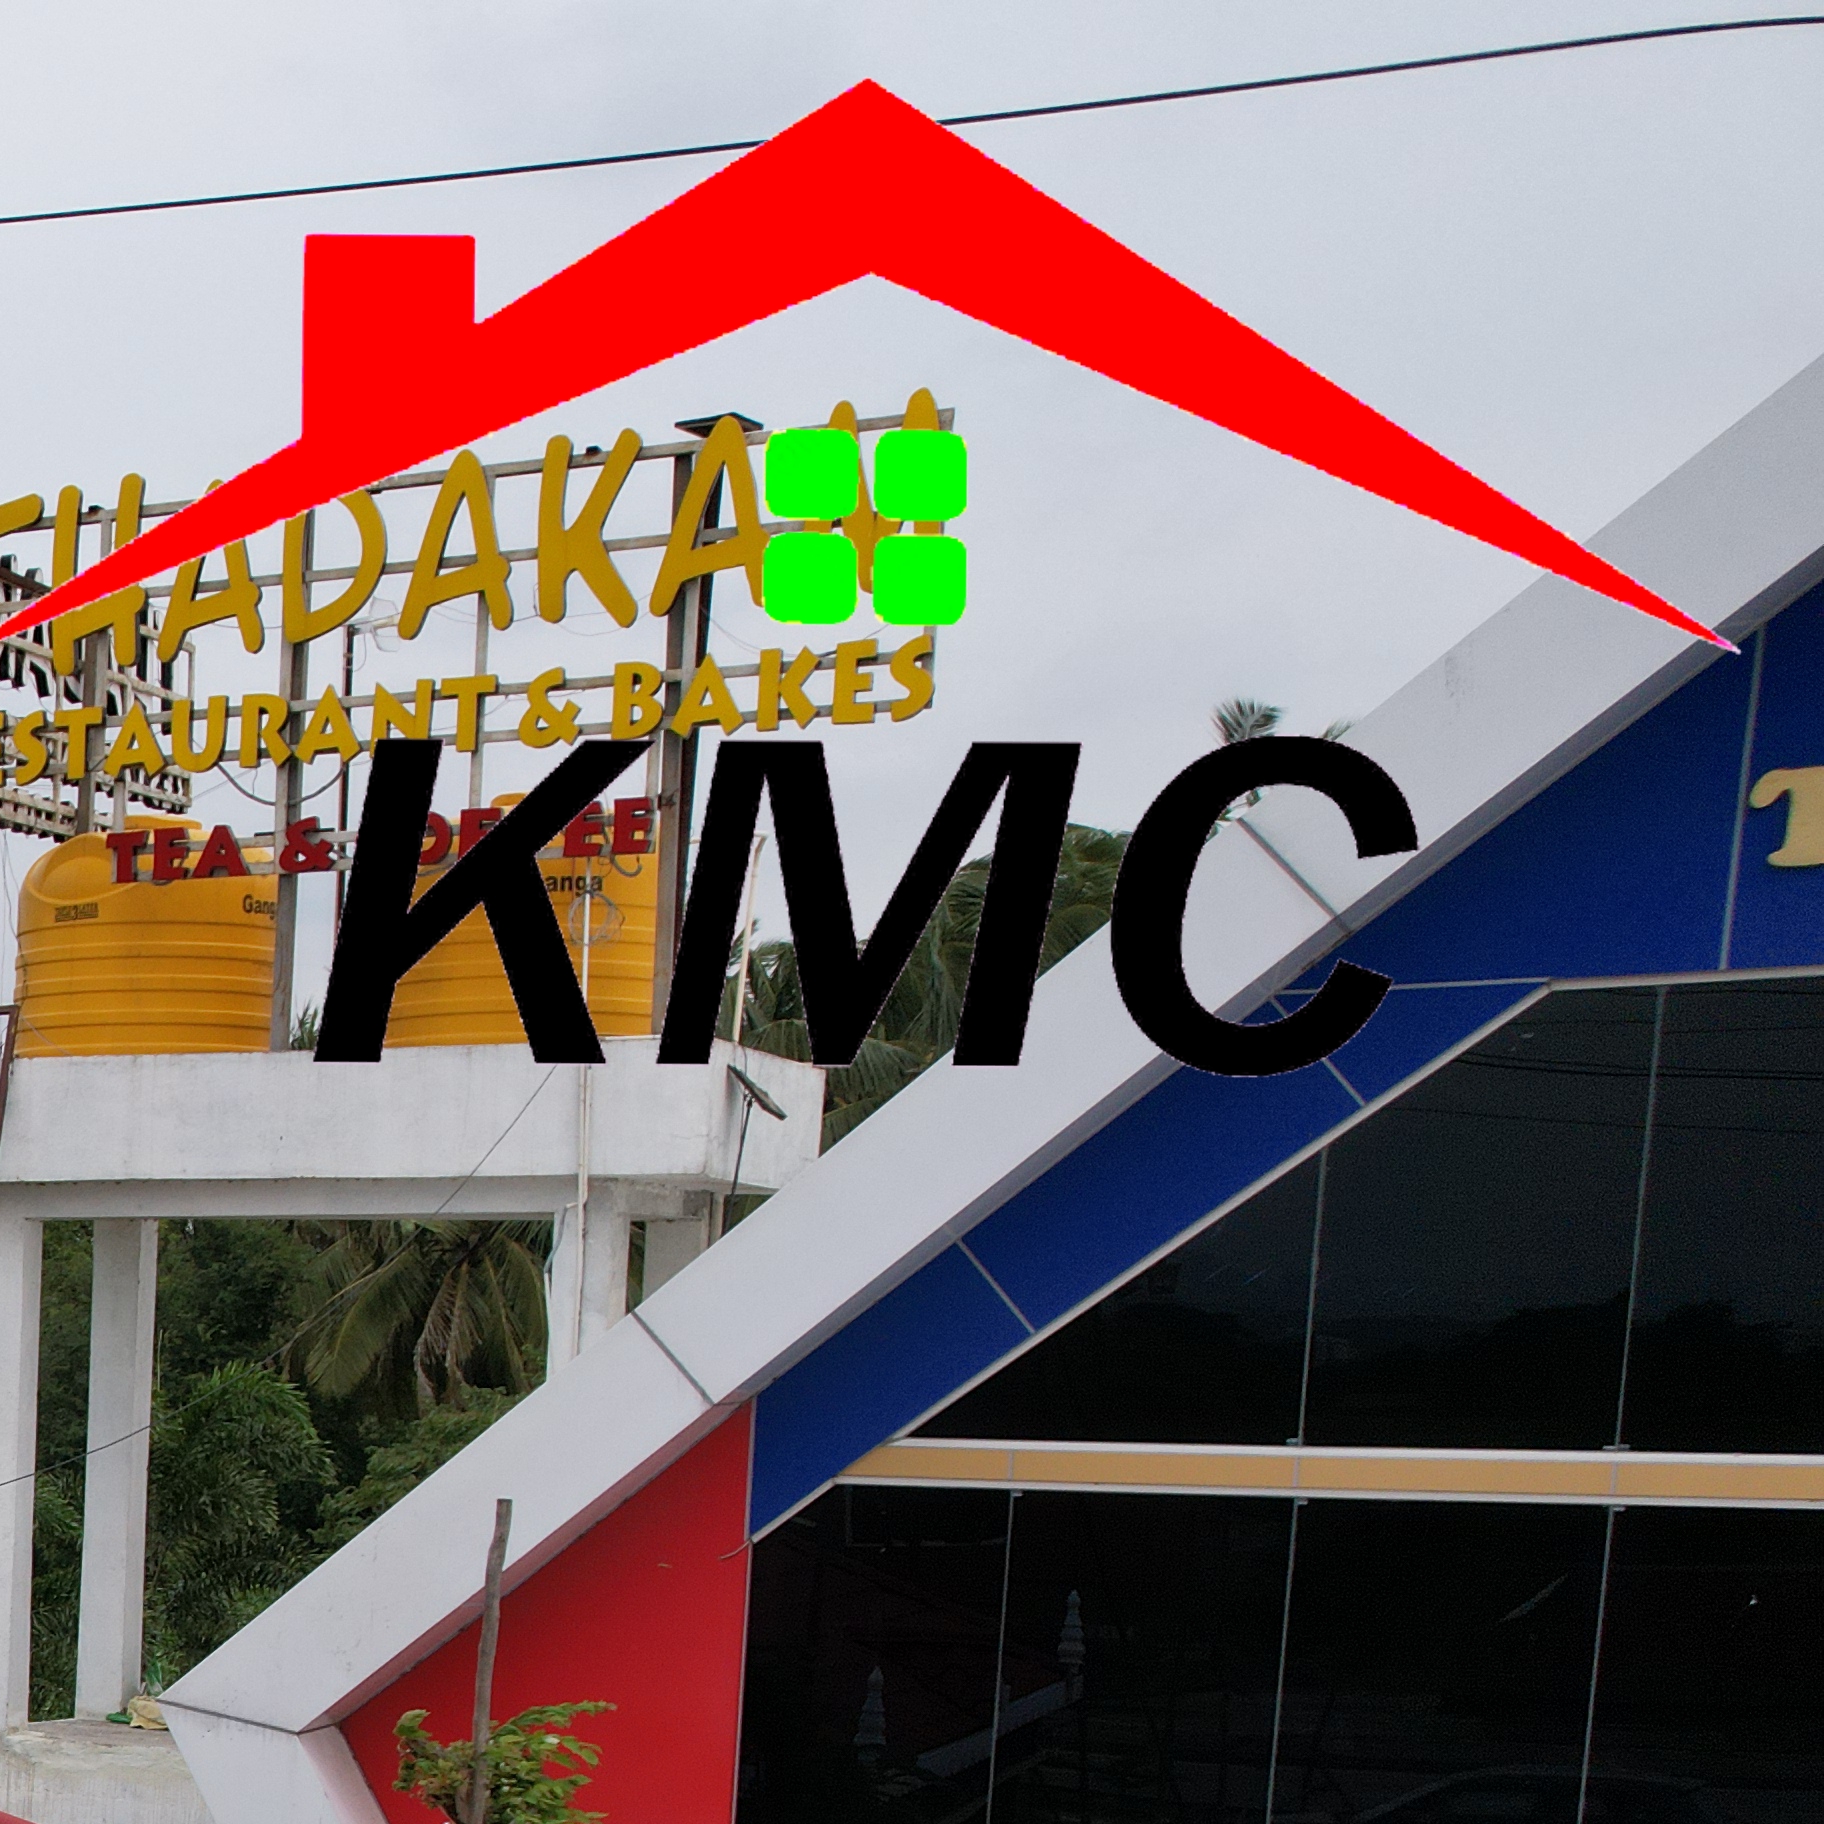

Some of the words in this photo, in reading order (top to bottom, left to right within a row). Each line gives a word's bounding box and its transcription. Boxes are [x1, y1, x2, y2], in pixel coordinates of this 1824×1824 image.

[516, 666, 584, 748] &
[610, 634, 935, 742] BAKES
[105, 824, 250, 885] TEA
[278, 816, 336, 874] &
